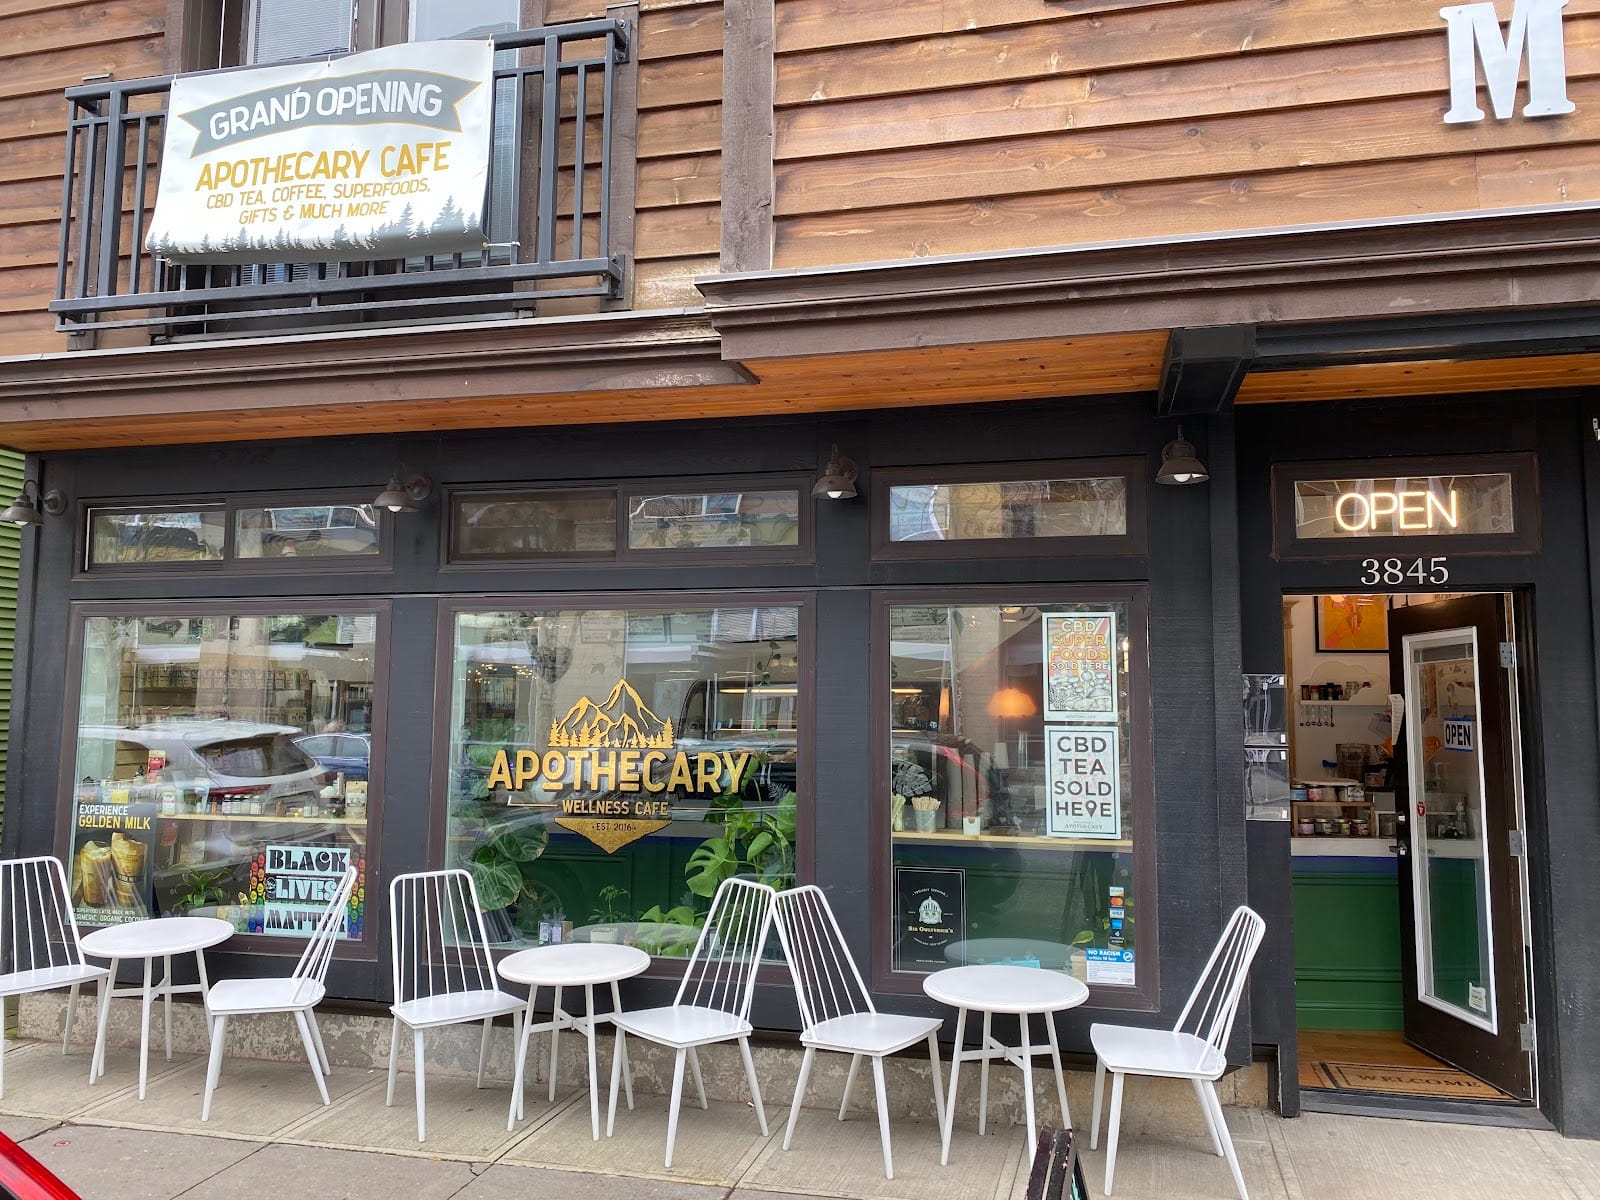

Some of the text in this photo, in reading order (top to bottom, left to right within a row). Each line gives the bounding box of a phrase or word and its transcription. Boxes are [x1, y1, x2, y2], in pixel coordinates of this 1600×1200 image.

[1439, 0, 1576, 124] M
[209, 80, 443, 140] GRAND OPENING
[195, 141, 452, 192] APOTHECARY CAFE
[206, 193, 234, 210] CBD
[272, 183, 327, 203] COFFEE,
[333, 178, 431, 199] SUPERFOODS,
[238, 200, 390, 225] GIFTS & MUCH MORE
[1335, 489, 1458, 532] OPEN
[1360, 557, 1449, 585] 3845
[1061, 620, 1096, 632] CBD
[1052, 634, 1106, 646] SUPER
[1050, 648, 1109, 660] FOODS
[1050, 662, 1109, 670] SOLD HERE
[1057, 736, 1107, 753] CBD
[1445, 723, 1471, 747] OPEN
[487, 749, 752, 793] APOTHECARY
[1058, 758, 1106, 775] TEA
[1054, 780, 1112, 796] SOLD
[79, 804, 129, 816] EXPERIENCE
[562, 800, 669, 816] WELLNESS CAFE
[1055, 799, 1112, 818] HEE
[79, 814, 151, 830] GOLDEN MILK
[596, 822, 632, 831] EST 2016
[269, 849, 347, 873] BLACK
[275, 879, 338, 901] LIVES
[265, 909, 346, 933] MATTR
[1356, 1074, 1481, 1088] WELCOME
